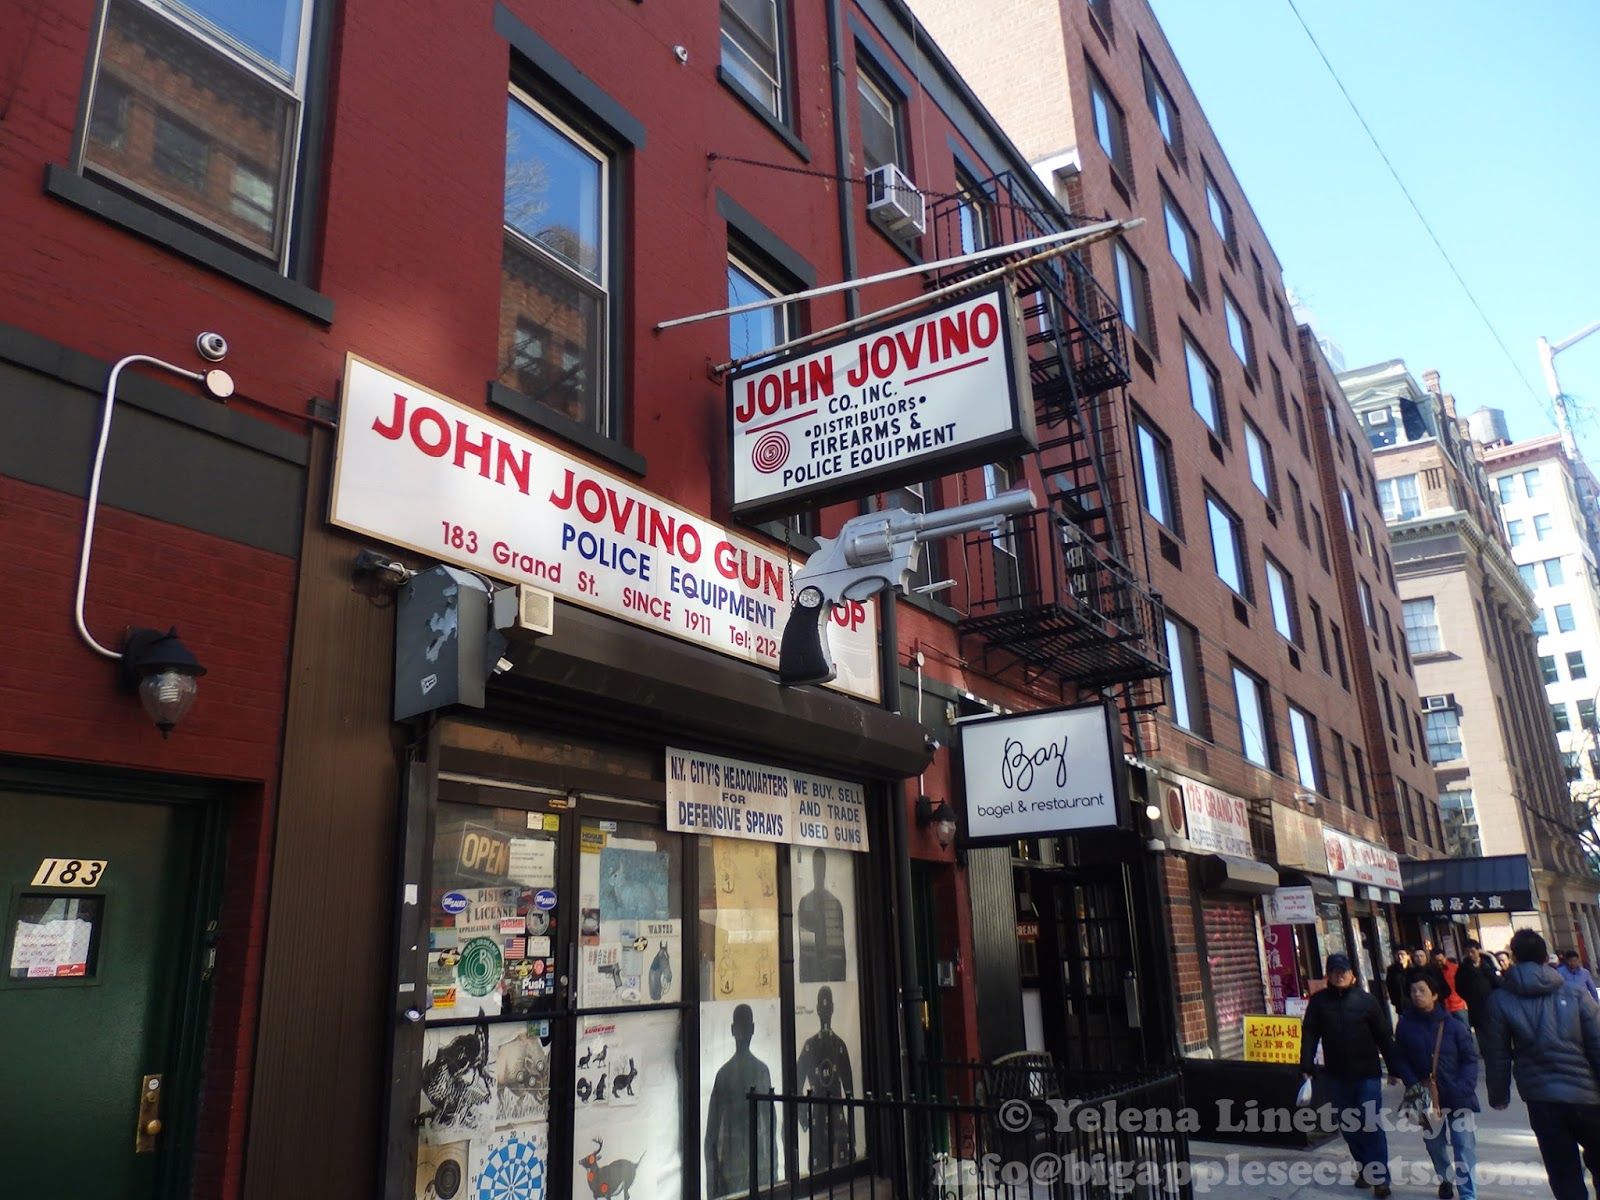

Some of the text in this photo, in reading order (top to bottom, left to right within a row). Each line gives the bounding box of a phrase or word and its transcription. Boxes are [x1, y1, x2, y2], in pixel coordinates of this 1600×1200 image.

[735, 302, 999, 423] JOHN JOVINO
[862, 381, 898, 406] INC.
[811, 412, 922, 459] FIREARMS &
[783, 423, 957, 487] POLICE EQUIPMENT
[371, 392, 866, 633] JOHN JOVINO GUN OP
[442, 522, 479, 554] 183
[493, 541, 561, 585] Grand
[577, 570, 599, 598] St.
[622, 587, 672, 622] SINCE
[684, 609, 711, 636] 1911
[729, 625, 752, 650] Tel:
[562, 522, 777, 630] POLICE EQUIPMENT
[690, 759, 720, 787] CITY'S
[723, 765, 788, 798] HEADQUARTERS
[793, 778, 808, 796] WE
[838, 787, 863, 805] SELL
[722, 792, 746, 805] FOR
[799, 800, 860, 823] AND TRADE
[977, 793, 1104, 819] bagel & restaurant
[1186, 782, 1202, 814] 179
[1204, 788, 1233, 824] GRAND
[1234, 800, 1248, 829] ST.
[678, 800, 783, 837] DEFENSIVE SPRAYS
[800, 821, 862, 844] USED GUNS
[462, 833, 508, 875] OPEN
[42, 860, 102, 885] 183
[475, 906, 513, 921] LICENSE
[648, 924, 673, 934] WANTED
[522, 978, 545, 990] Push
[725, 974, 768, 991] 4 5
